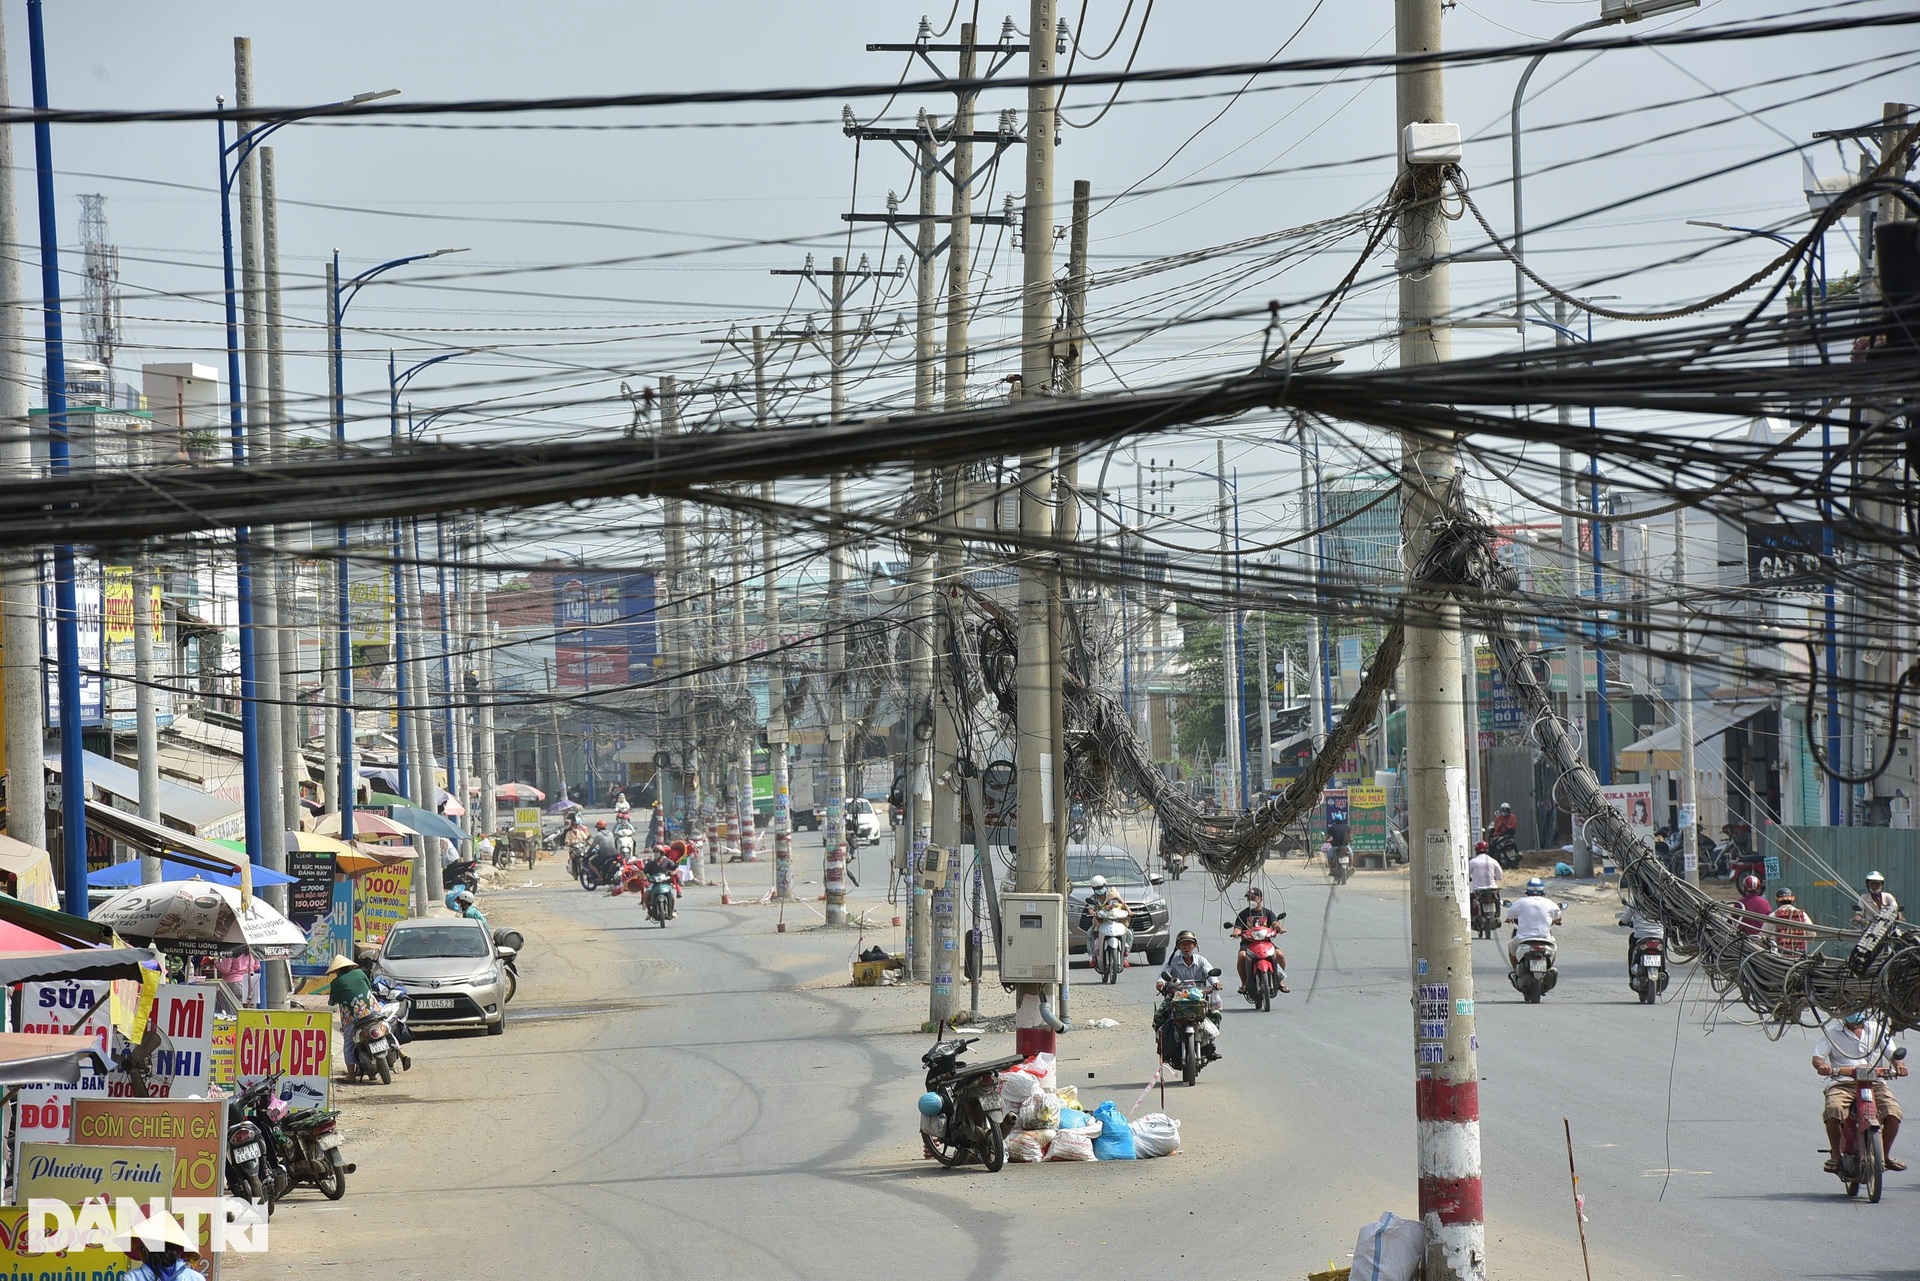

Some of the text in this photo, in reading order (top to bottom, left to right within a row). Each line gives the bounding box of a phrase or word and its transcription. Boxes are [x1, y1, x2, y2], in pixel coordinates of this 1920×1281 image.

[589, 608, 619, 624] WORLD
[38, 979, 96, 1009] SỬA
[168, 992, 205, 1039] MÌ
[240, 1014, 327, 1076] GIÀY DÉP
[156, 1049, 202, 1077] NHI
[80, 1111, 218, 1140] CƠM CHIÊN GÀ
[28, 1155, 162, 1185] Phương Trinh
